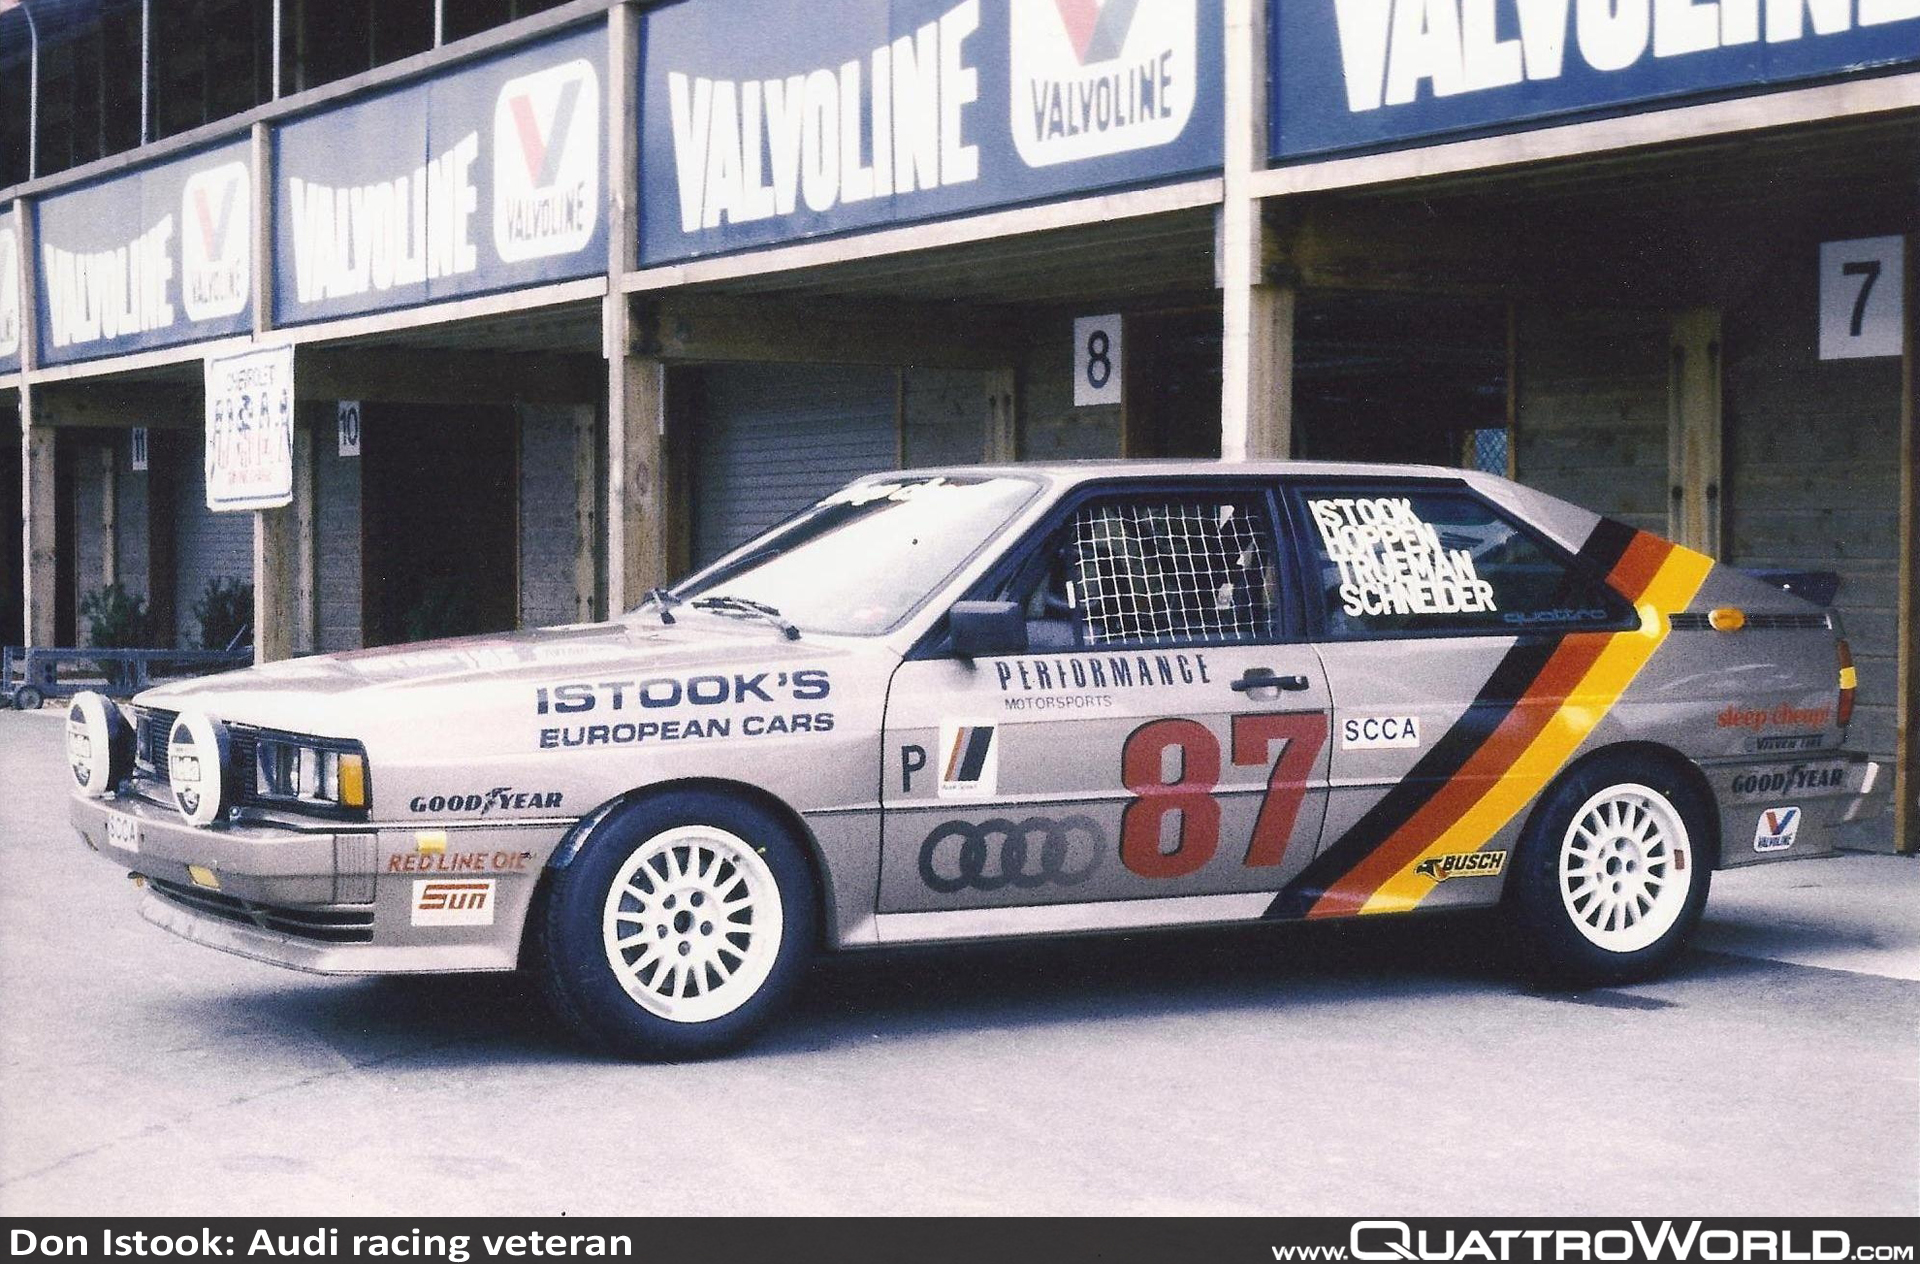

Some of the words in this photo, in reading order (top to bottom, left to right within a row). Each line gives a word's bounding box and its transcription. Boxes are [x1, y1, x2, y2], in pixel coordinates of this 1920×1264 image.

[1030, 48, 1173, 142] VALVOLINE
[667, 0, 980, 234] VALVOLINE
[289, 129, 479, 304] VALVOLINE
[505, 180, 587, 243] VALVOLINE
[43, 212, 174, 348] VALVOLINE
[1842, 259, 1882, 338] 7
[1086, 329, 1112, 390] 8
[134, 430, 147, 463] 11
[338, 407, 360, 447] 10
[1307, 497, 1423, 530] ISTOOK
[1319, 522, 1443, 561] HOPPEN
[1336, 549, 1479, 585] TRUEMAN
[1338, 579, 1498, 617] SCHNEIDER
[536, 668, 831, 715] ISTOOK'S
[995, 653, 1212, 692] PERFORMANCE
[1004, 694, 1114, 711] MOTORSPORTS
[539, 717, 732, 749] EUROPEAN
[742, 711, 835, 737] CARS
[1345, 718, 1417, 742] SCCA
[901, 744, 927, 793] P
[1731, 764, 1844, 795] GOODYEAR
[409, 786, 565, 816] GOODYEAR
[1119, 708, 1329, 880] 87
[387, 851, 432, 872] RED
[437, 851, 486, 872] LINE
[1441, 852, 1504, 871] BUSCH
